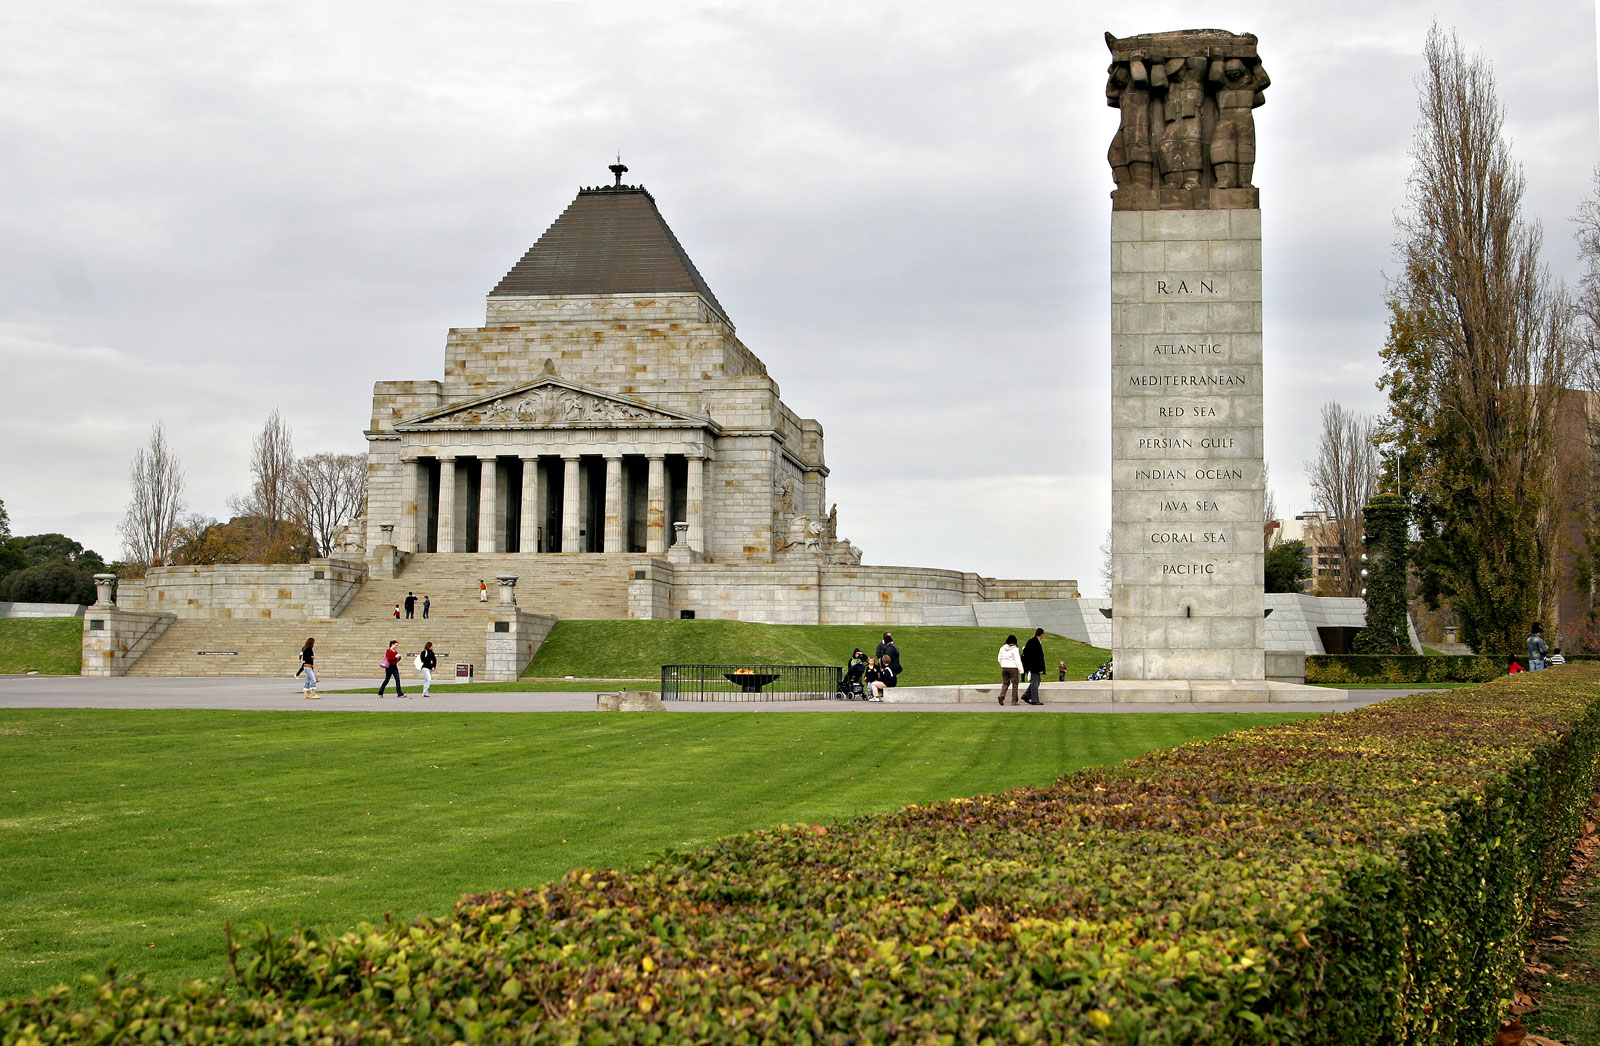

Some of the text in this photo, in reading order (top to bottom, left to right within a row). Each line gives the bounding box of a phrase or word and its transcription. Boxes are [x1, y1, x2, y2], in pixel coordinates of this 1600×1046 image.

[1152, 343, 1222, 355] ATLANTIC
[1129, 375, 1246, 386] MEDITERRANEAN
[1159, 406, 1216, 418] RED SEA
[1139, 438, 1235, 449] PERSIAN GULF
[1135, 469, 1243, 480] INDIAN OCEAN
[1160, 500, 1219, 513] JAVA SEA
[1150, 532, 1227, 544] CORAL SEA
[1162, 563, 1215, 575] PACIFIC
